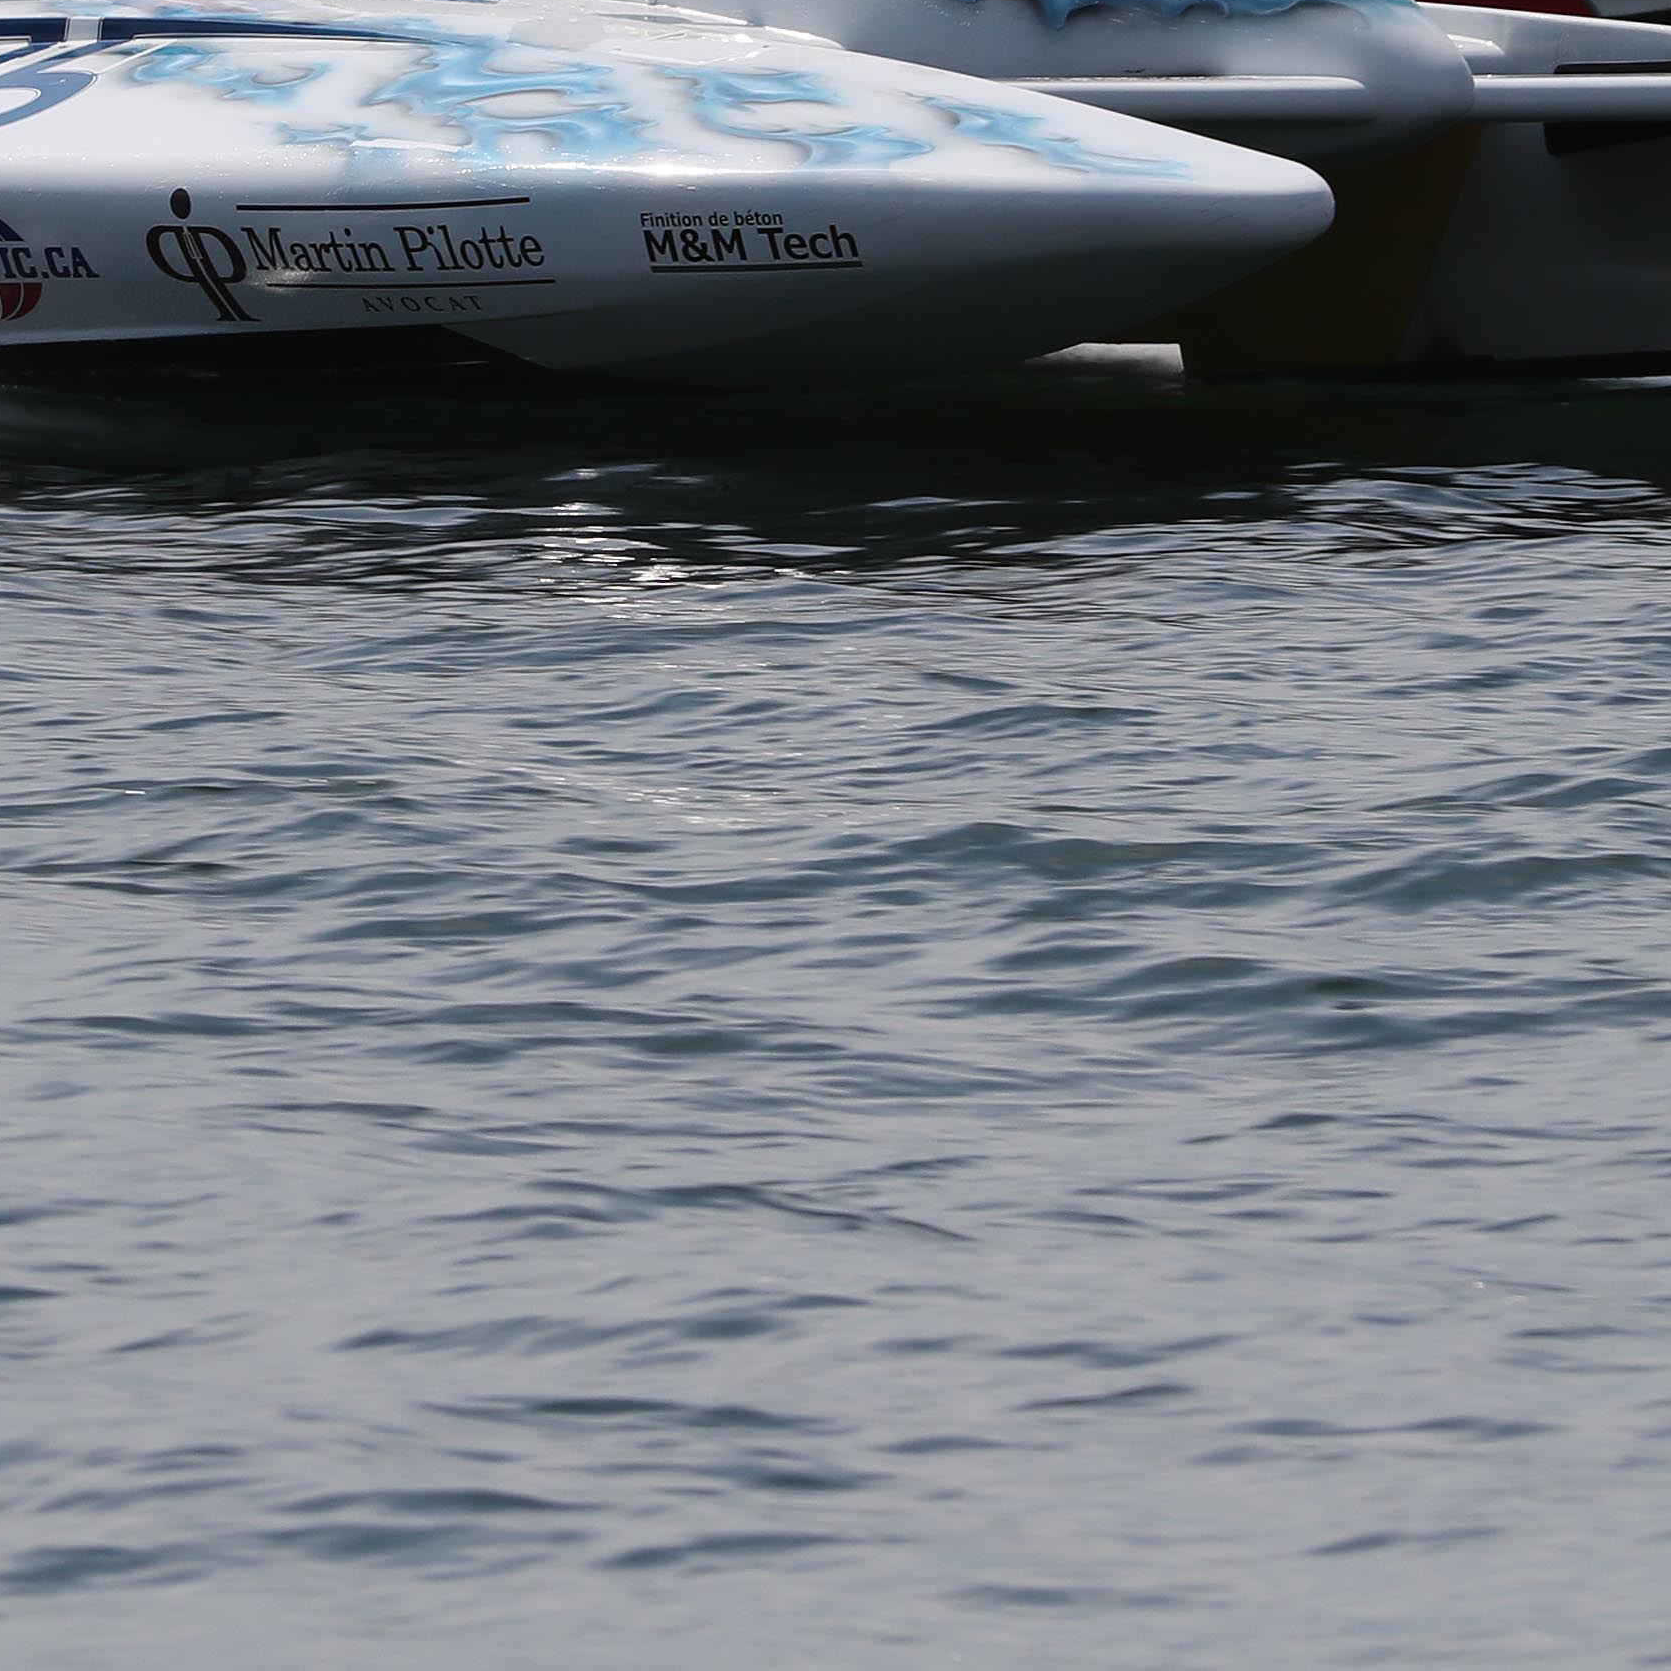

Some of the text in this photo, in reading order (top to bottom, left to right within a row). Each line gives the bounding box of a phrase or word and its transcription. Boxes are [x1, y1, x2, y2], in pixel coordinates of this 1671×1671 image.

[640, 209, 783, 228] Finition de béton
[240, 224, 546, 273] Martin Pilotte
[643, 224, 860, 263] M&M Tech
[360, 294, 483, 313] AVOCAT
